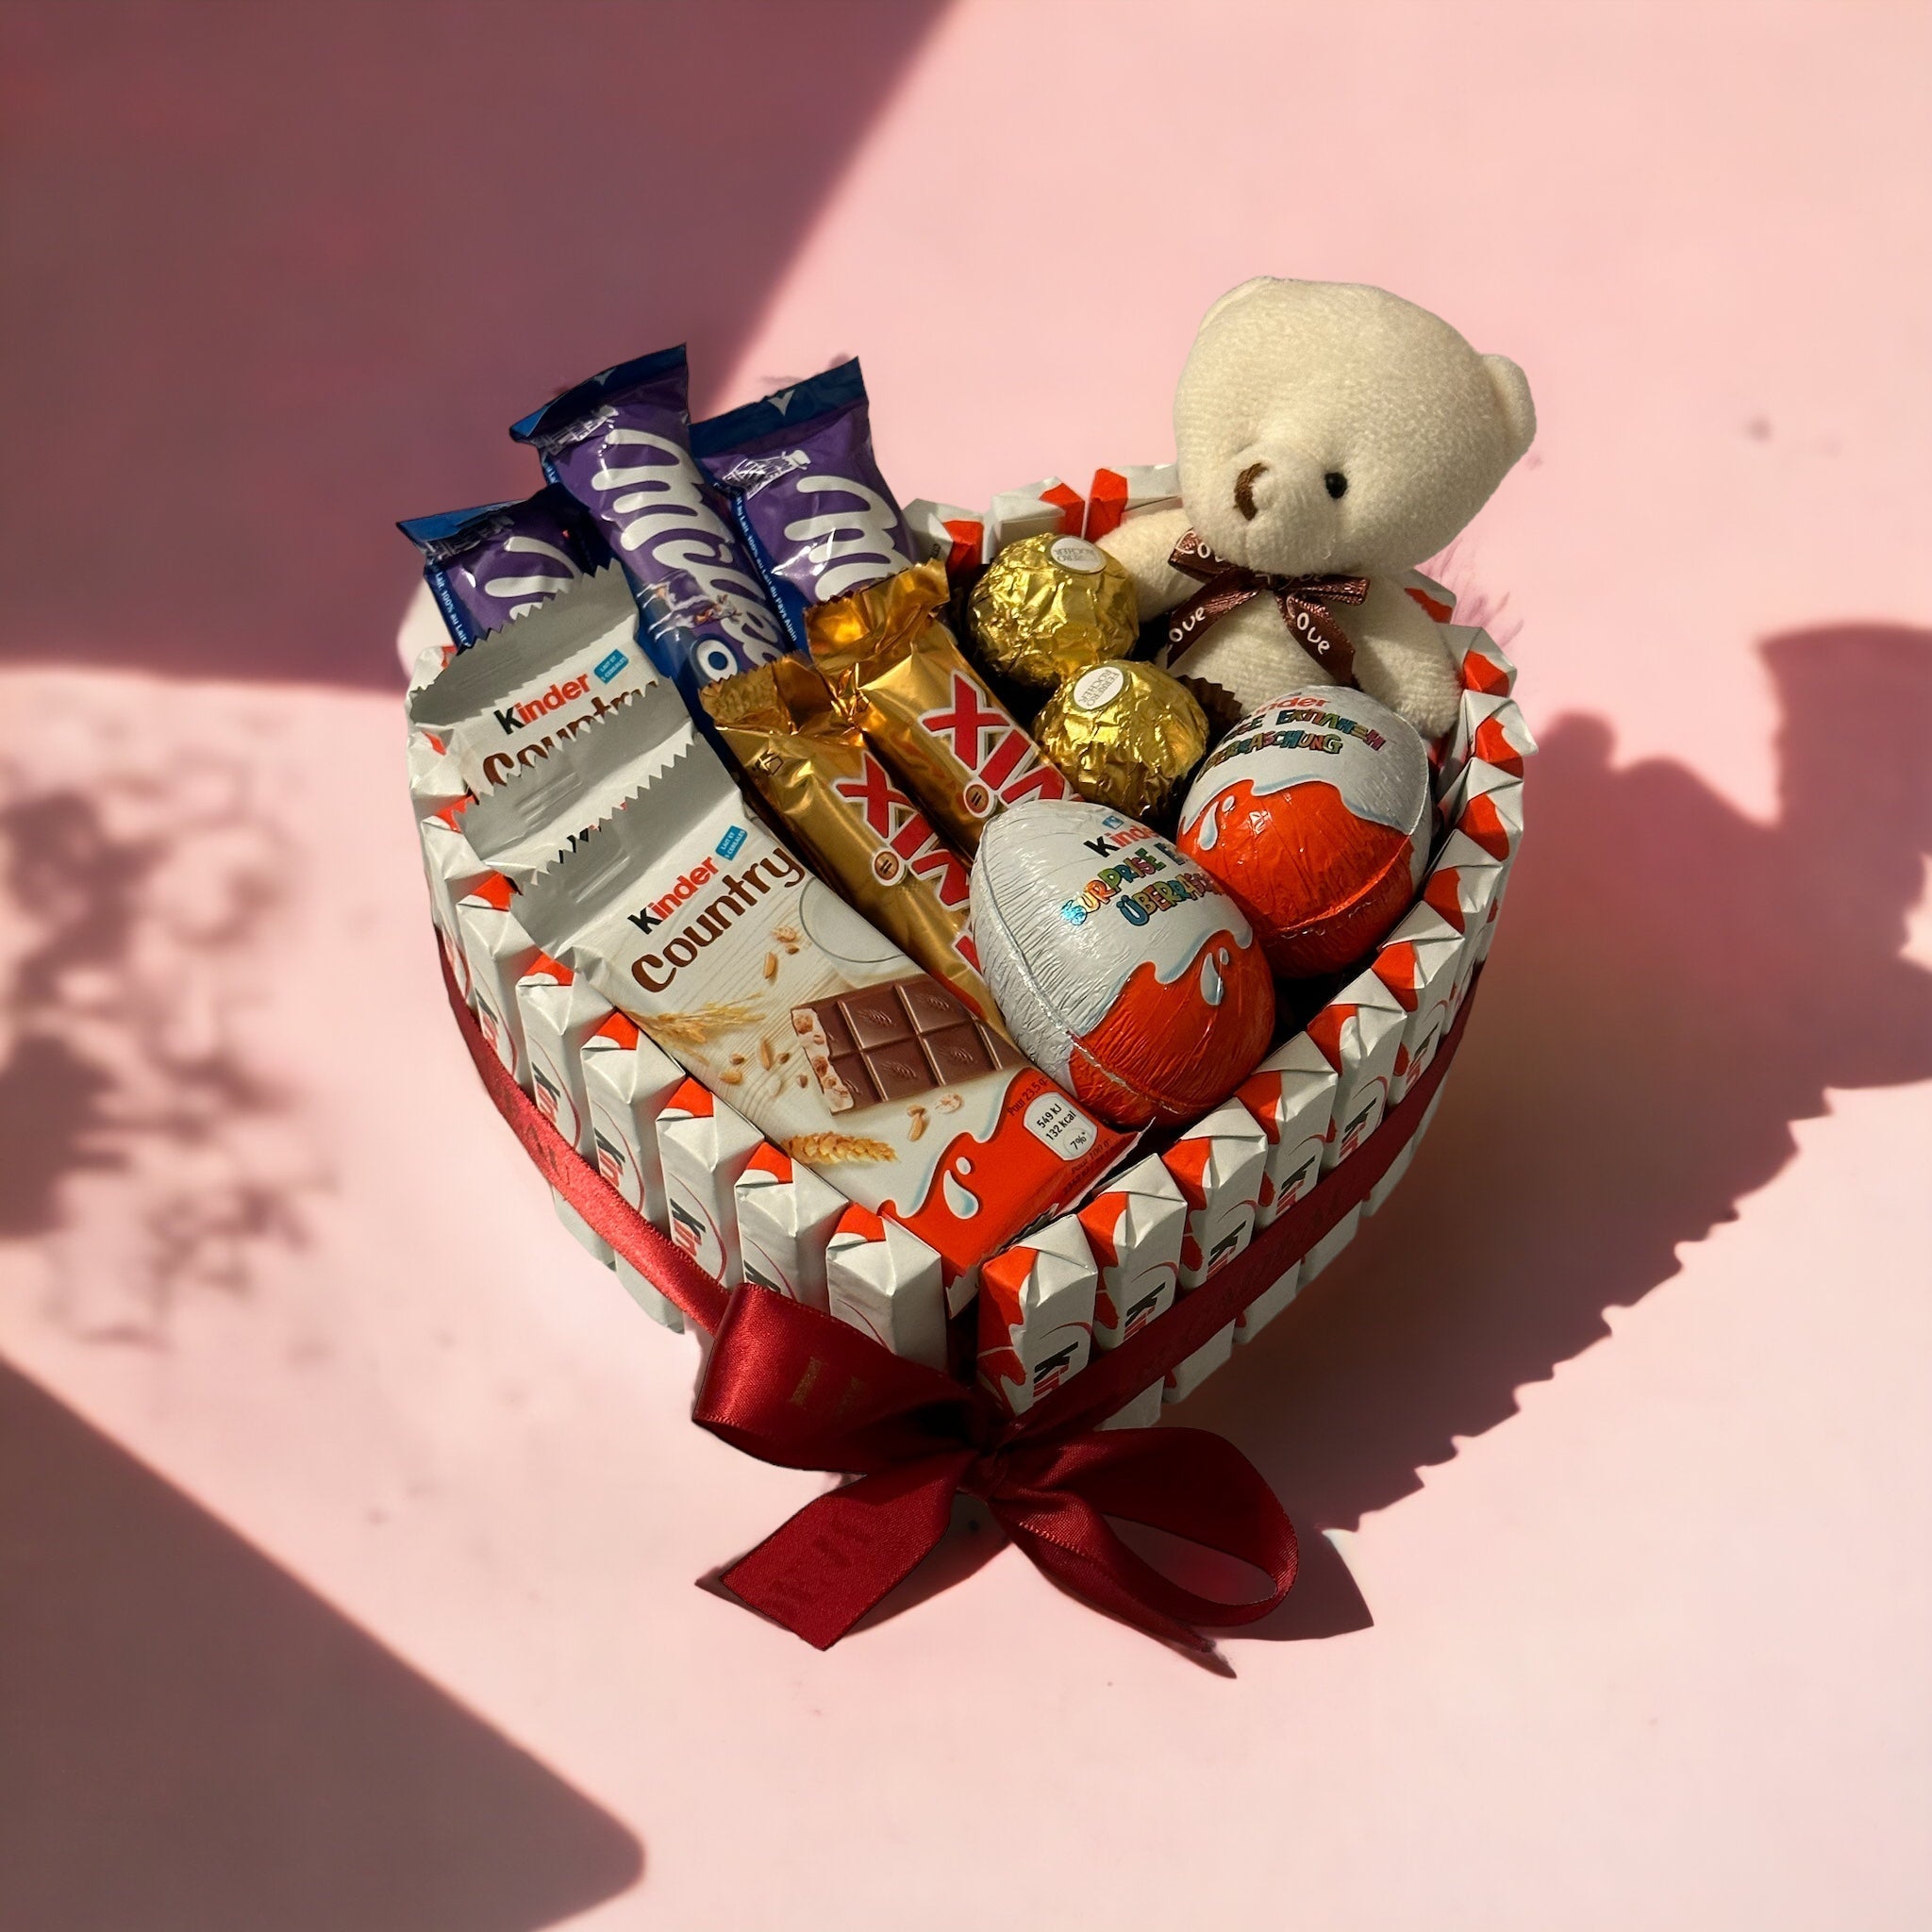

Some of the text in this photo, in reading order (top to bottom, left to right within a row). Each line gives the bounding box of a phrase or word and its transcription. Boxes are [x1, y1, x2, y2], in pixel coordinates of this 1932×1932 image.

[441, 590, 455, 613] 100%
[775, 597, 788, 619] Pays
[784, 618, 798, 641] Alpin
[1078, 669, 1113, 704] ROCHER
[1087, 672, 1121, 707] FERRERO
[631, 847, 806, 992] Country
[1036, 1103, 1063, 1129] 549 kJ
[1045, 1110, 1077, 1141] 132 kcal
